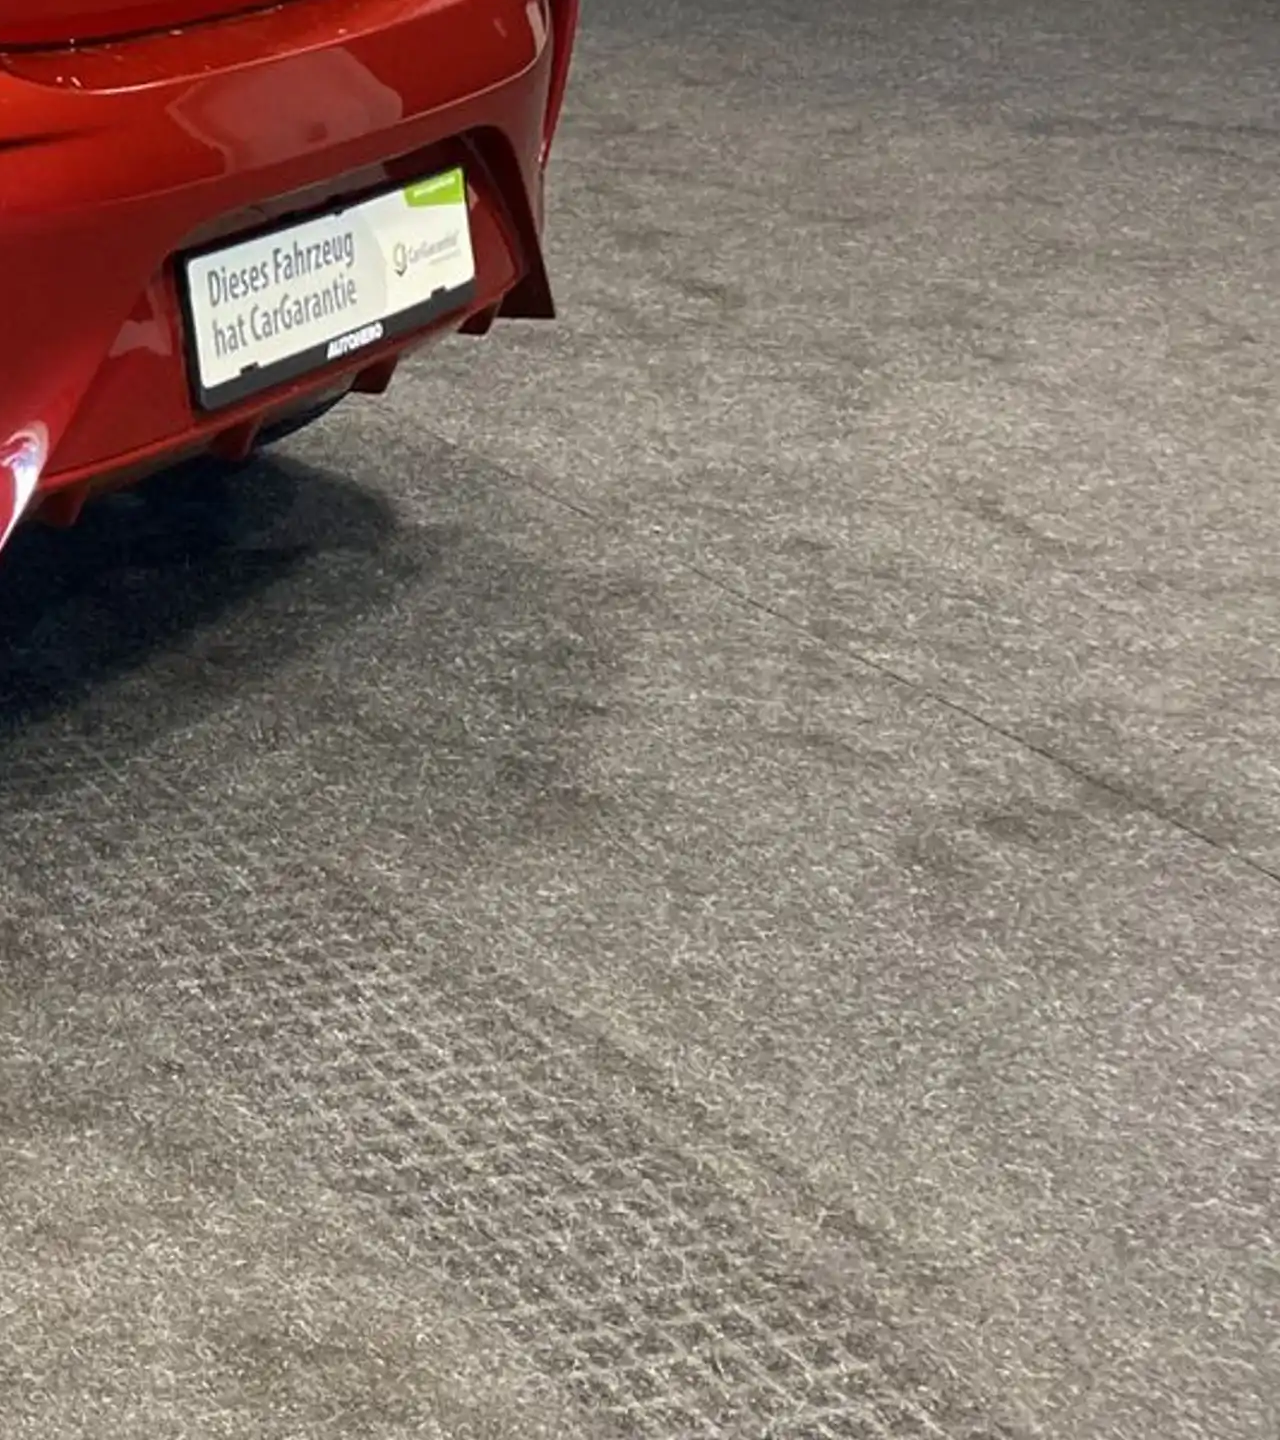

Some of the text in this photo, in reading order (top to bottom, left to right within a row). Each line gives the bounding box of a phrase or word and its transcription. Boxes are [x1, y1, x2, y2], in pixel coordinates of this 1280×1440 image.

[207, 264, 270, 308] Dieses
[272, 231, 355, 285] Fahrzeug
[212, 274, 358, 358] hat CarGarantie
